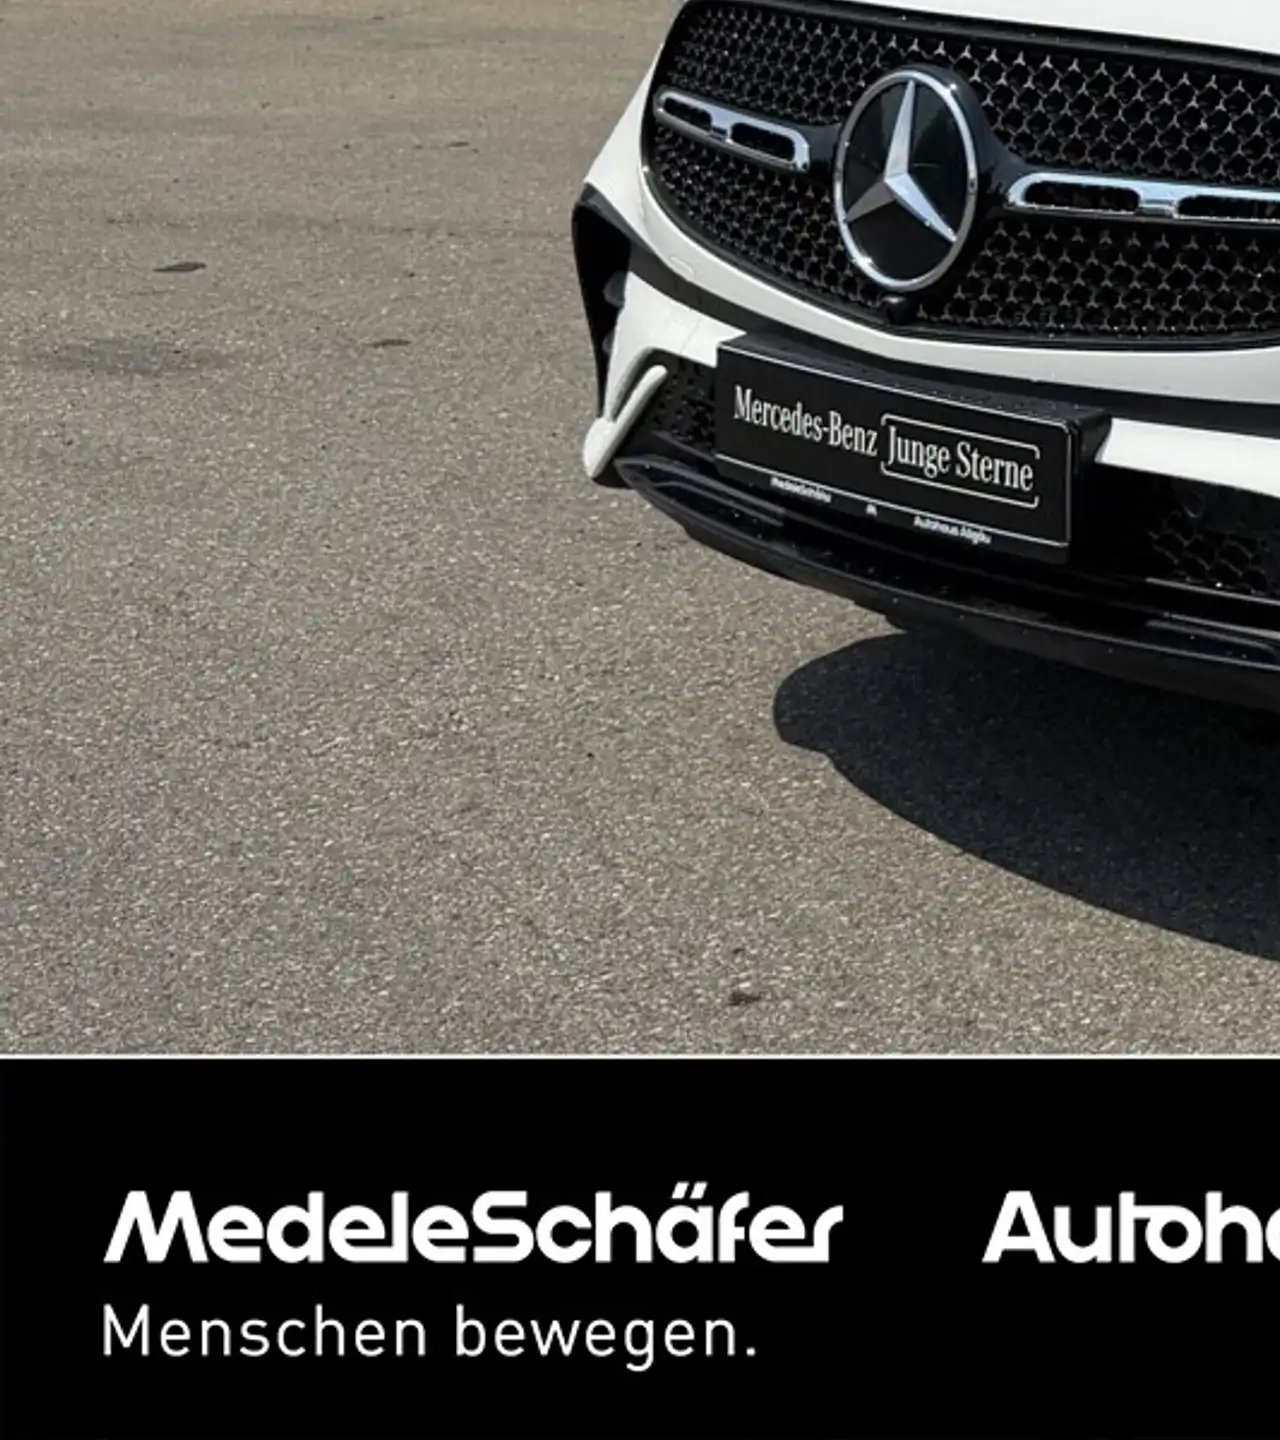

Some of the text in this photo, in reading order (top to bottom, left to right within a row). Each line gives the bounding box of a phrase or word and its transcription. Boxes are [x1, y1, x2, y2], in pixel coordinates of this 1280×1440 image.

[733, 384, 1035, 492] Mercedes-Benz Junge Sterne
